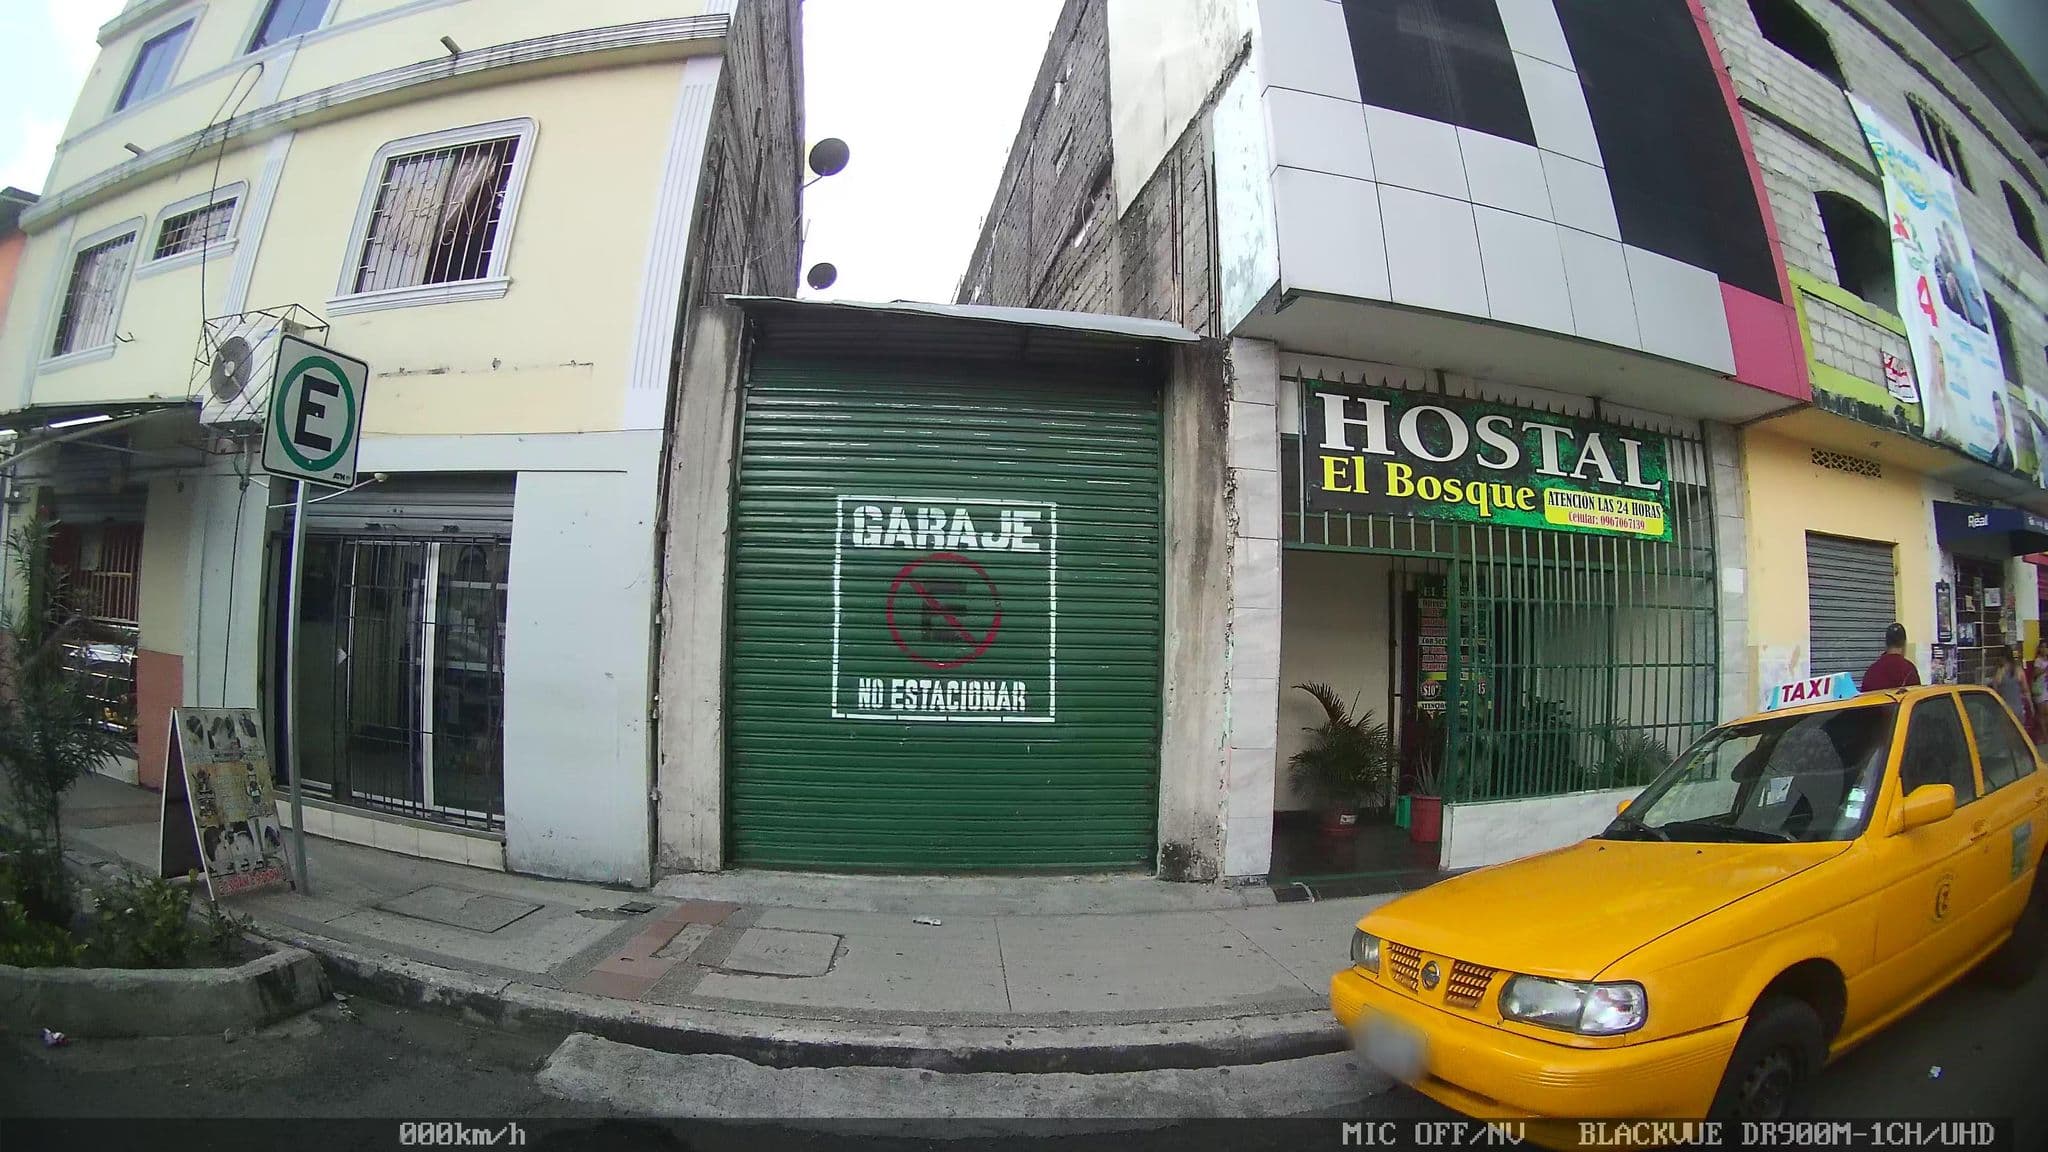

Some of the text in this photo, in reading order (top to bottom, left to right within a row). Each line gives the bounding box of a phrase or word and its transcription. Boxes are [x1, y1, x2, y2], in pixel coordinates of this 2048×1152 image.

[294, 373, 340, 453] E
[1315, 392, 1662, 491] HOSTAL
[1319, 455, 1536, 518] El Bosque
[1598, 497, 1614, 512] LAS
[1617, 501, 1629, 514] 24
[1632, 502, 1662, 519] HORAS
[852, 506, 1042, 552] GARAJE
[857, 678, 1026, 712] NO ESTACIONAR
[1782, 677, 1831, 702] TAXI
